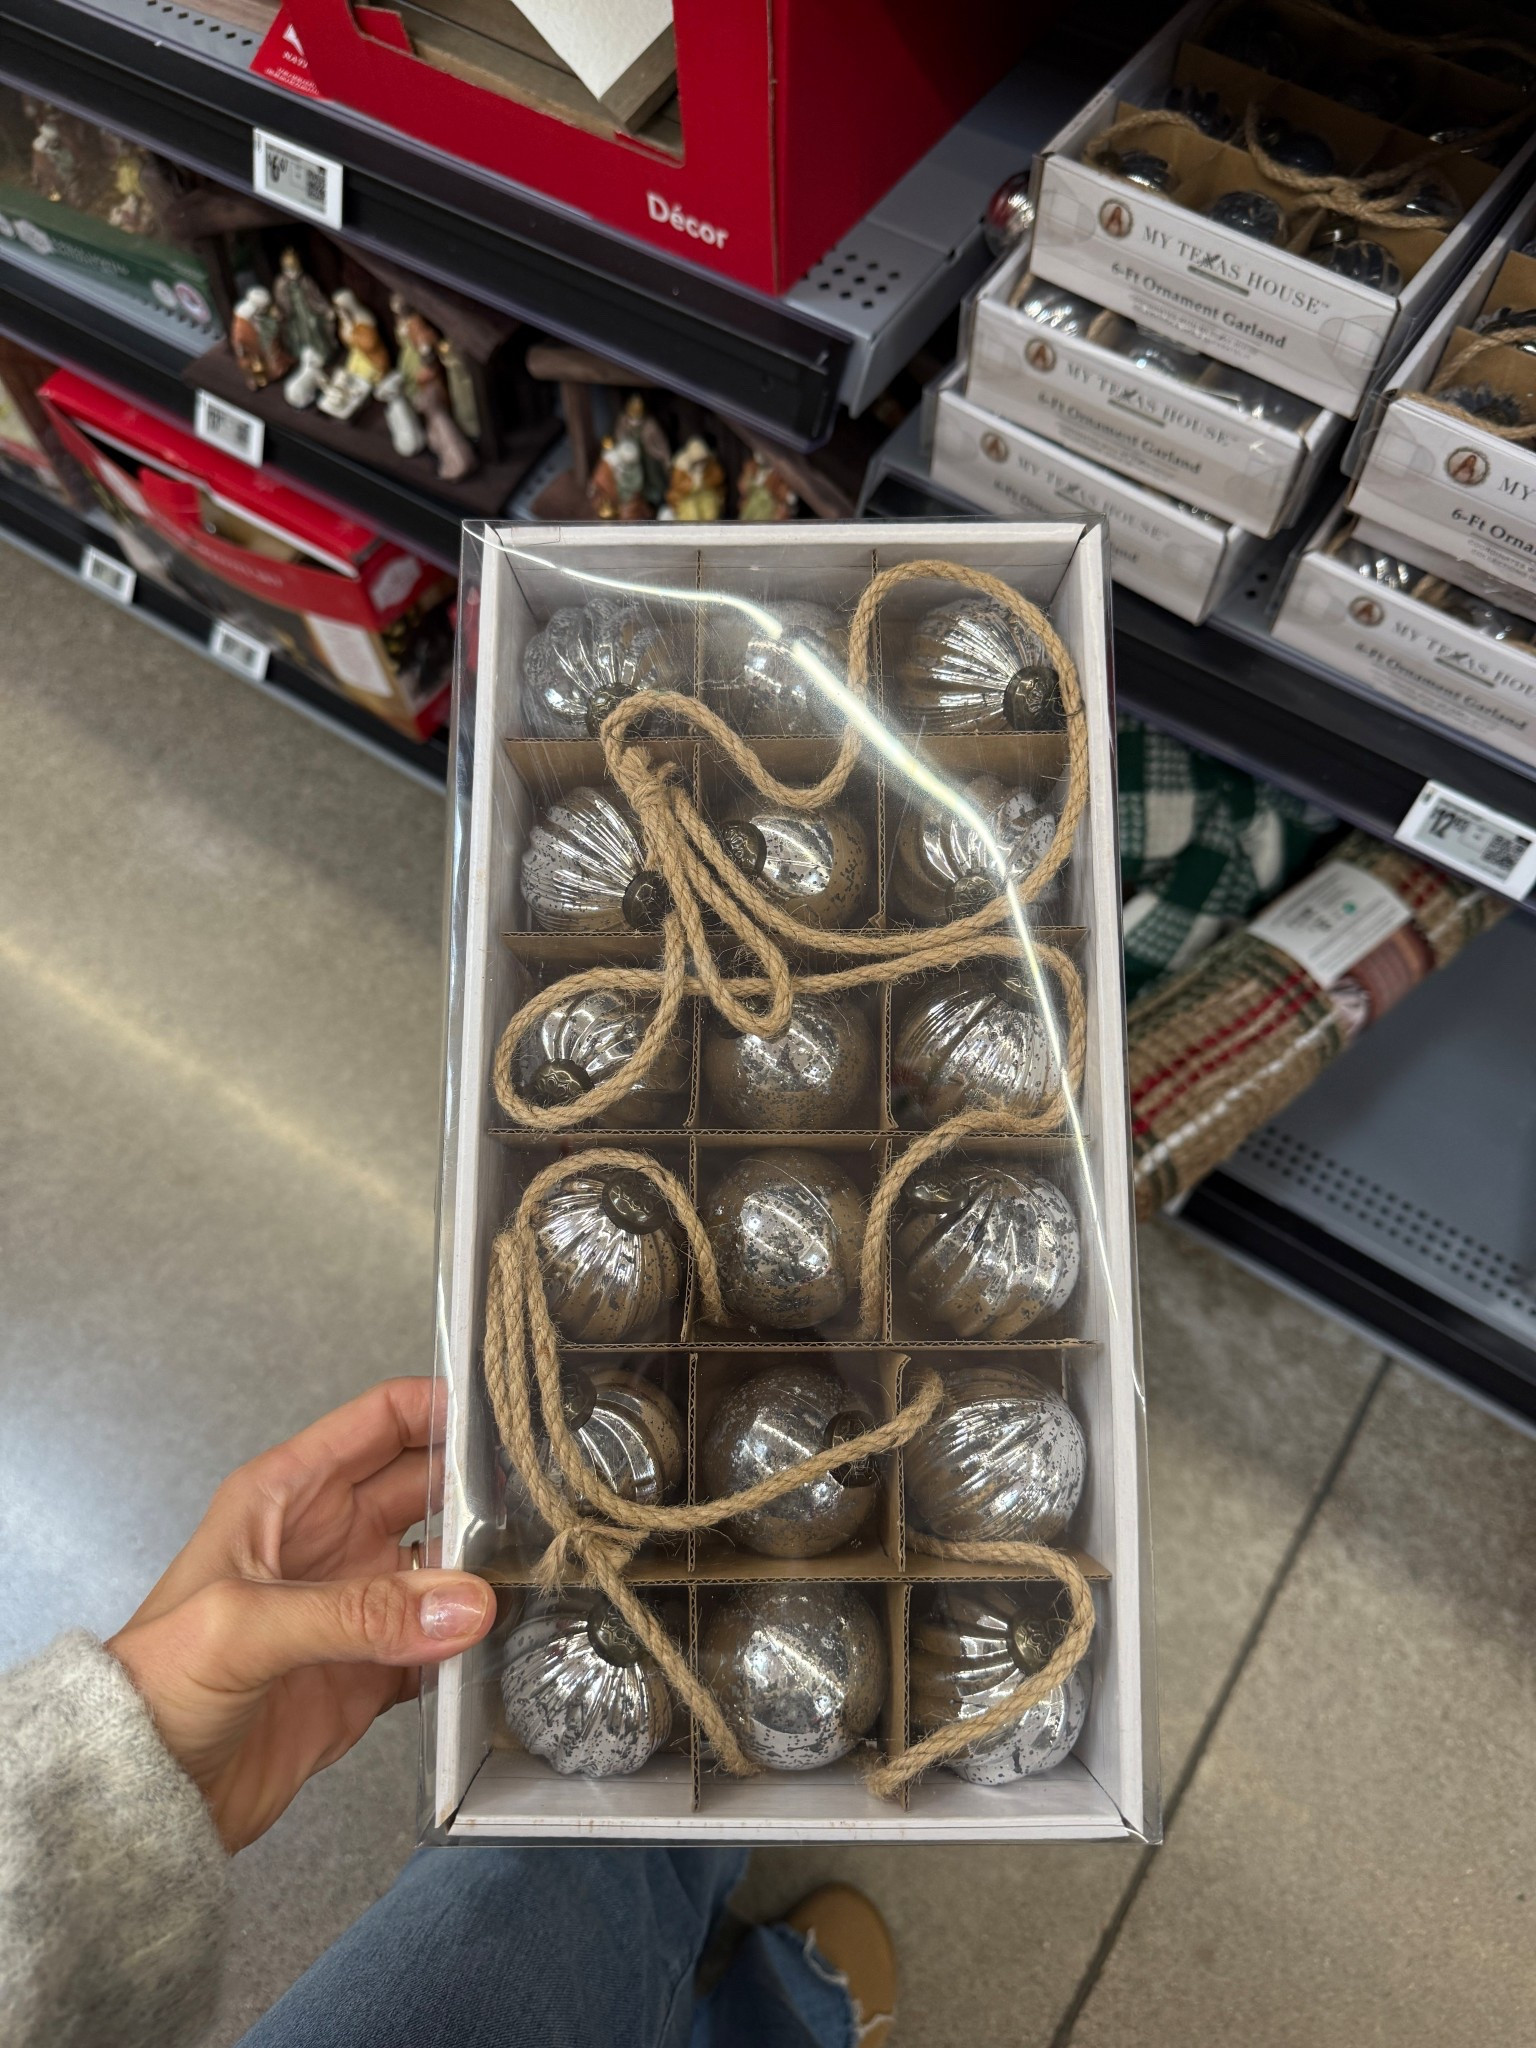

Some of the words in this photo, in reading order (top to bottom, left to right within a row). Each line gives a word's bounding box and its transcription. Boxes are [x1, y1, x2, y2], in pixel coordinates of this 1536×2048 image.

[646, 190, 729, 250] Décor
[1142, 226, 1173, 249] MY
[1177, 241, 1241, 280] TEXAS
[1111, 263, 1140, 285] 6-Ft
[1142, 277, 1219, 321] Ornament
[1222, 312, 1288, 349] Garland
[1141, 439, 1203, 474] Garland
[1498, 476, 1536, 501] MY
[1451, 508, 1486, 531] 6-Ft
[1490, 525, 1536, 557] Orna
[1463, 695, 1528, 731] Garland
